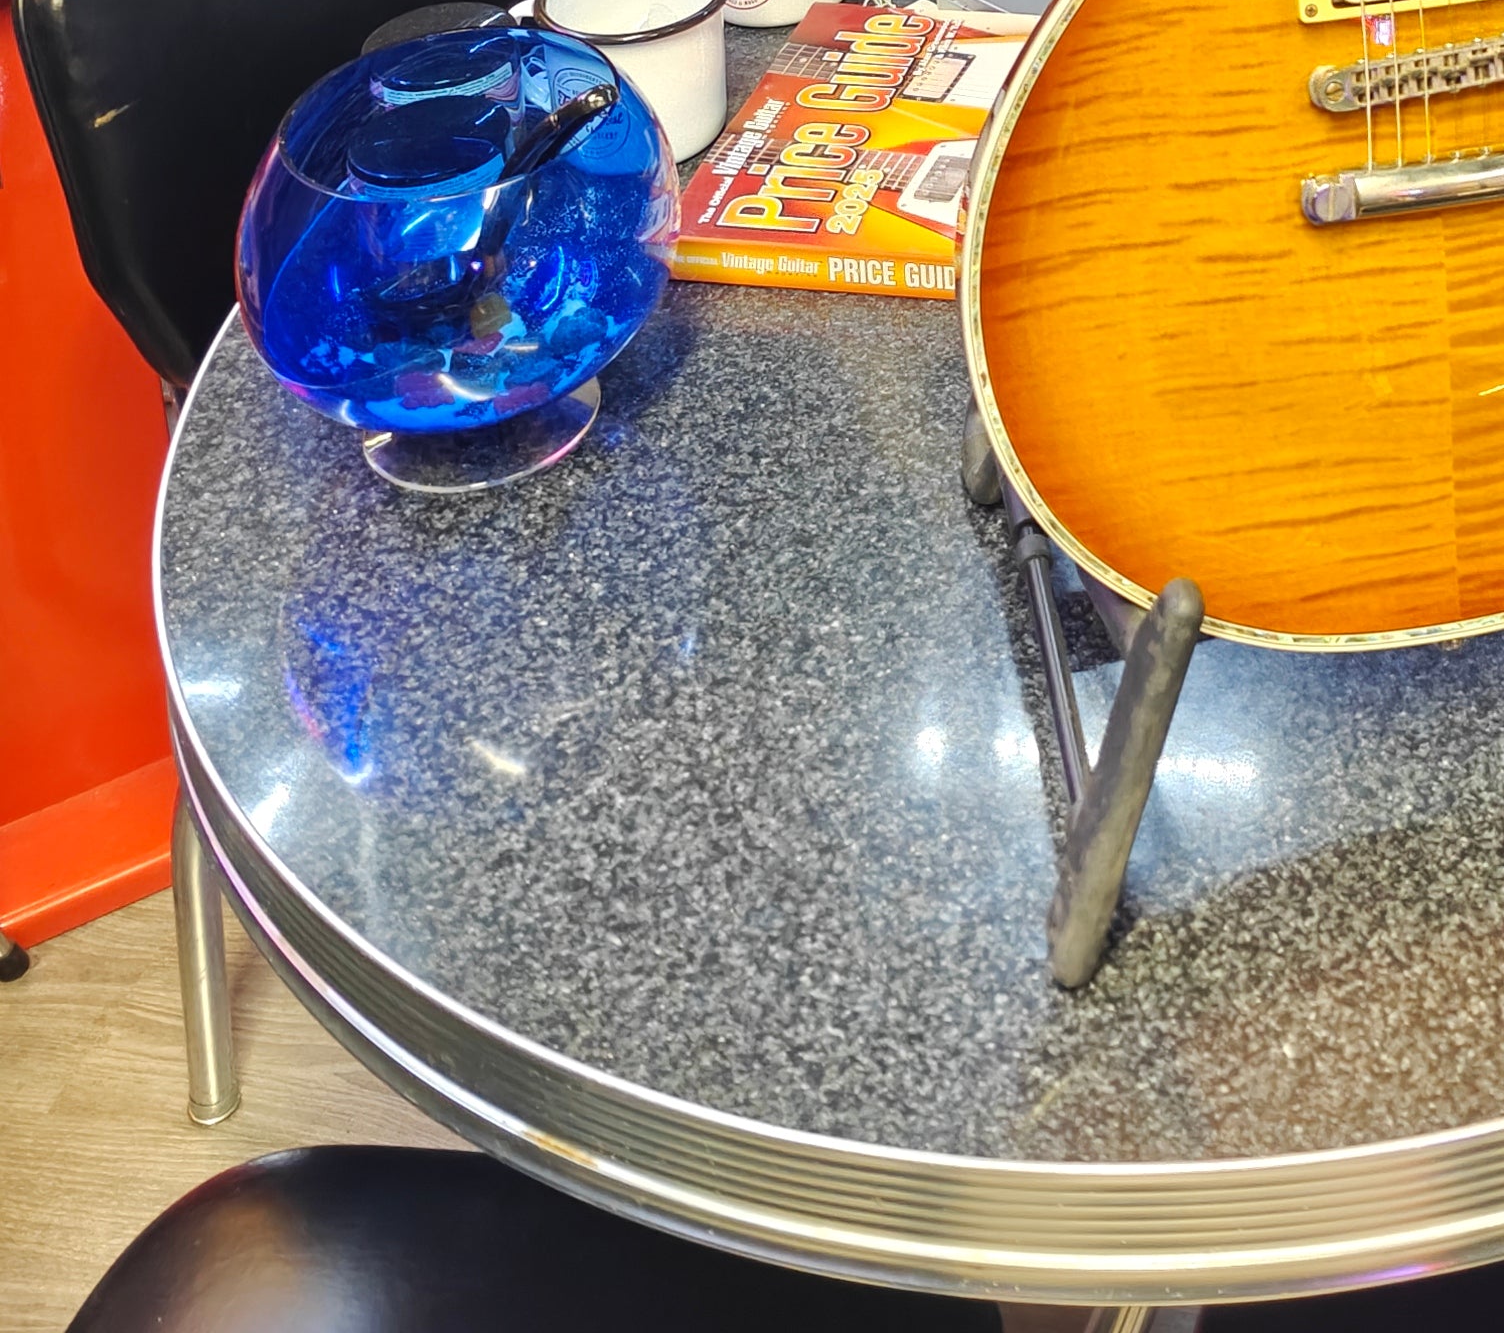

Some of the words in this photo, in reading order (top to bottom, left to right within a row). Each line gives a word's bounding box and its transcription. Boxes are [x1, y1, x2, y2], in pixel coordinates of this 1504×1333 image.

[716, 122, 871, 234] Price
[795, 14, 937, 112] Guide
[698, 207, 716, 224] The
[712, 130, 765, 176] Vintage
[826, 168, 885, 235] 2025
[720, 252, 774, 275] Vintage
[777, 255, 820, 274] Guitar
[828, 257, 896, 286] PRICE
[904, 263, 956, 291] GUID
